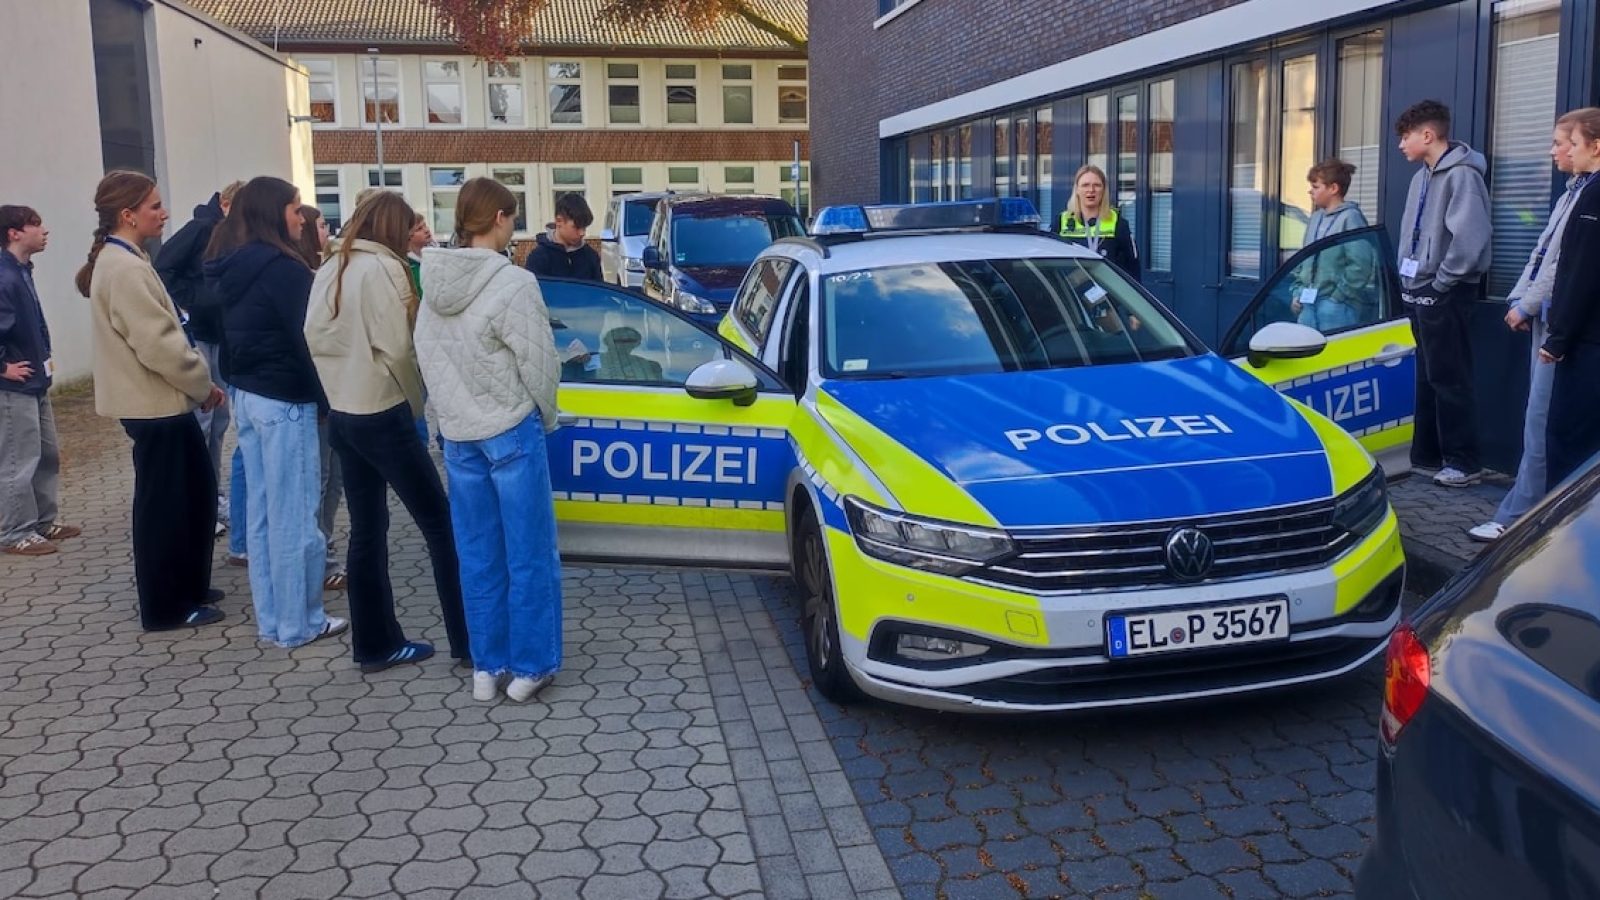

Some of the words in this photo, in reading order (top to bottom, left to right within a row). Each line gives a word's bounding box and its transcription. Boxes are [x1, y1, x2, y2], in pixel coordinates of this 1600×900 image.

[1003, 414, 1233, 451] POLIZEI
[572, 439, 758, 485] POLIZEI
[1129, 619, 1168, 649] EL
[1187, 614, 1205, 643] P
[1213, 605, 1281, 641] 3567
